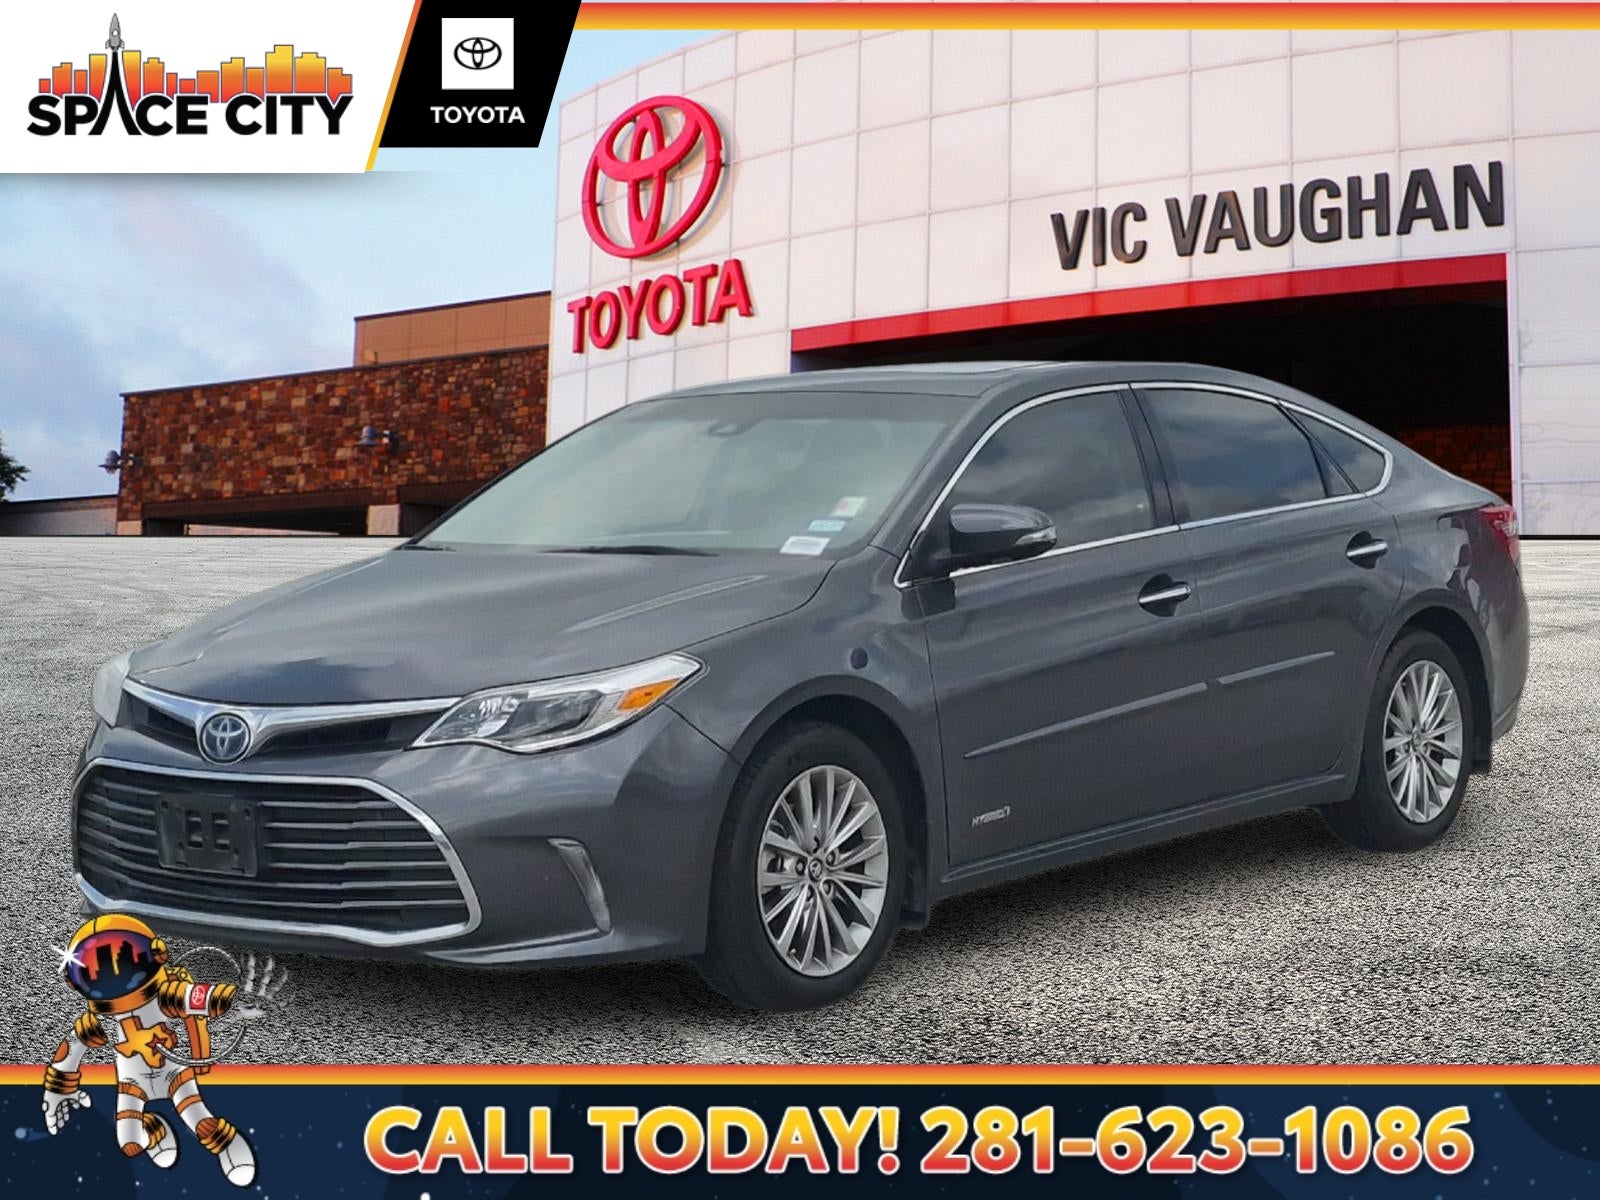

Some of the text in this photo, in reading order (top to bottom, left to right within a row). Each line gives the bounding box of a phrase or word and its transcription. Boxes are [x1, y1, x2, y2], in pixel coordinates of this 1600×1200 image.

[1050, 161, 1505, 270] VIC VAUGHAN
[567, 259, 754, 354] TOYOTA
